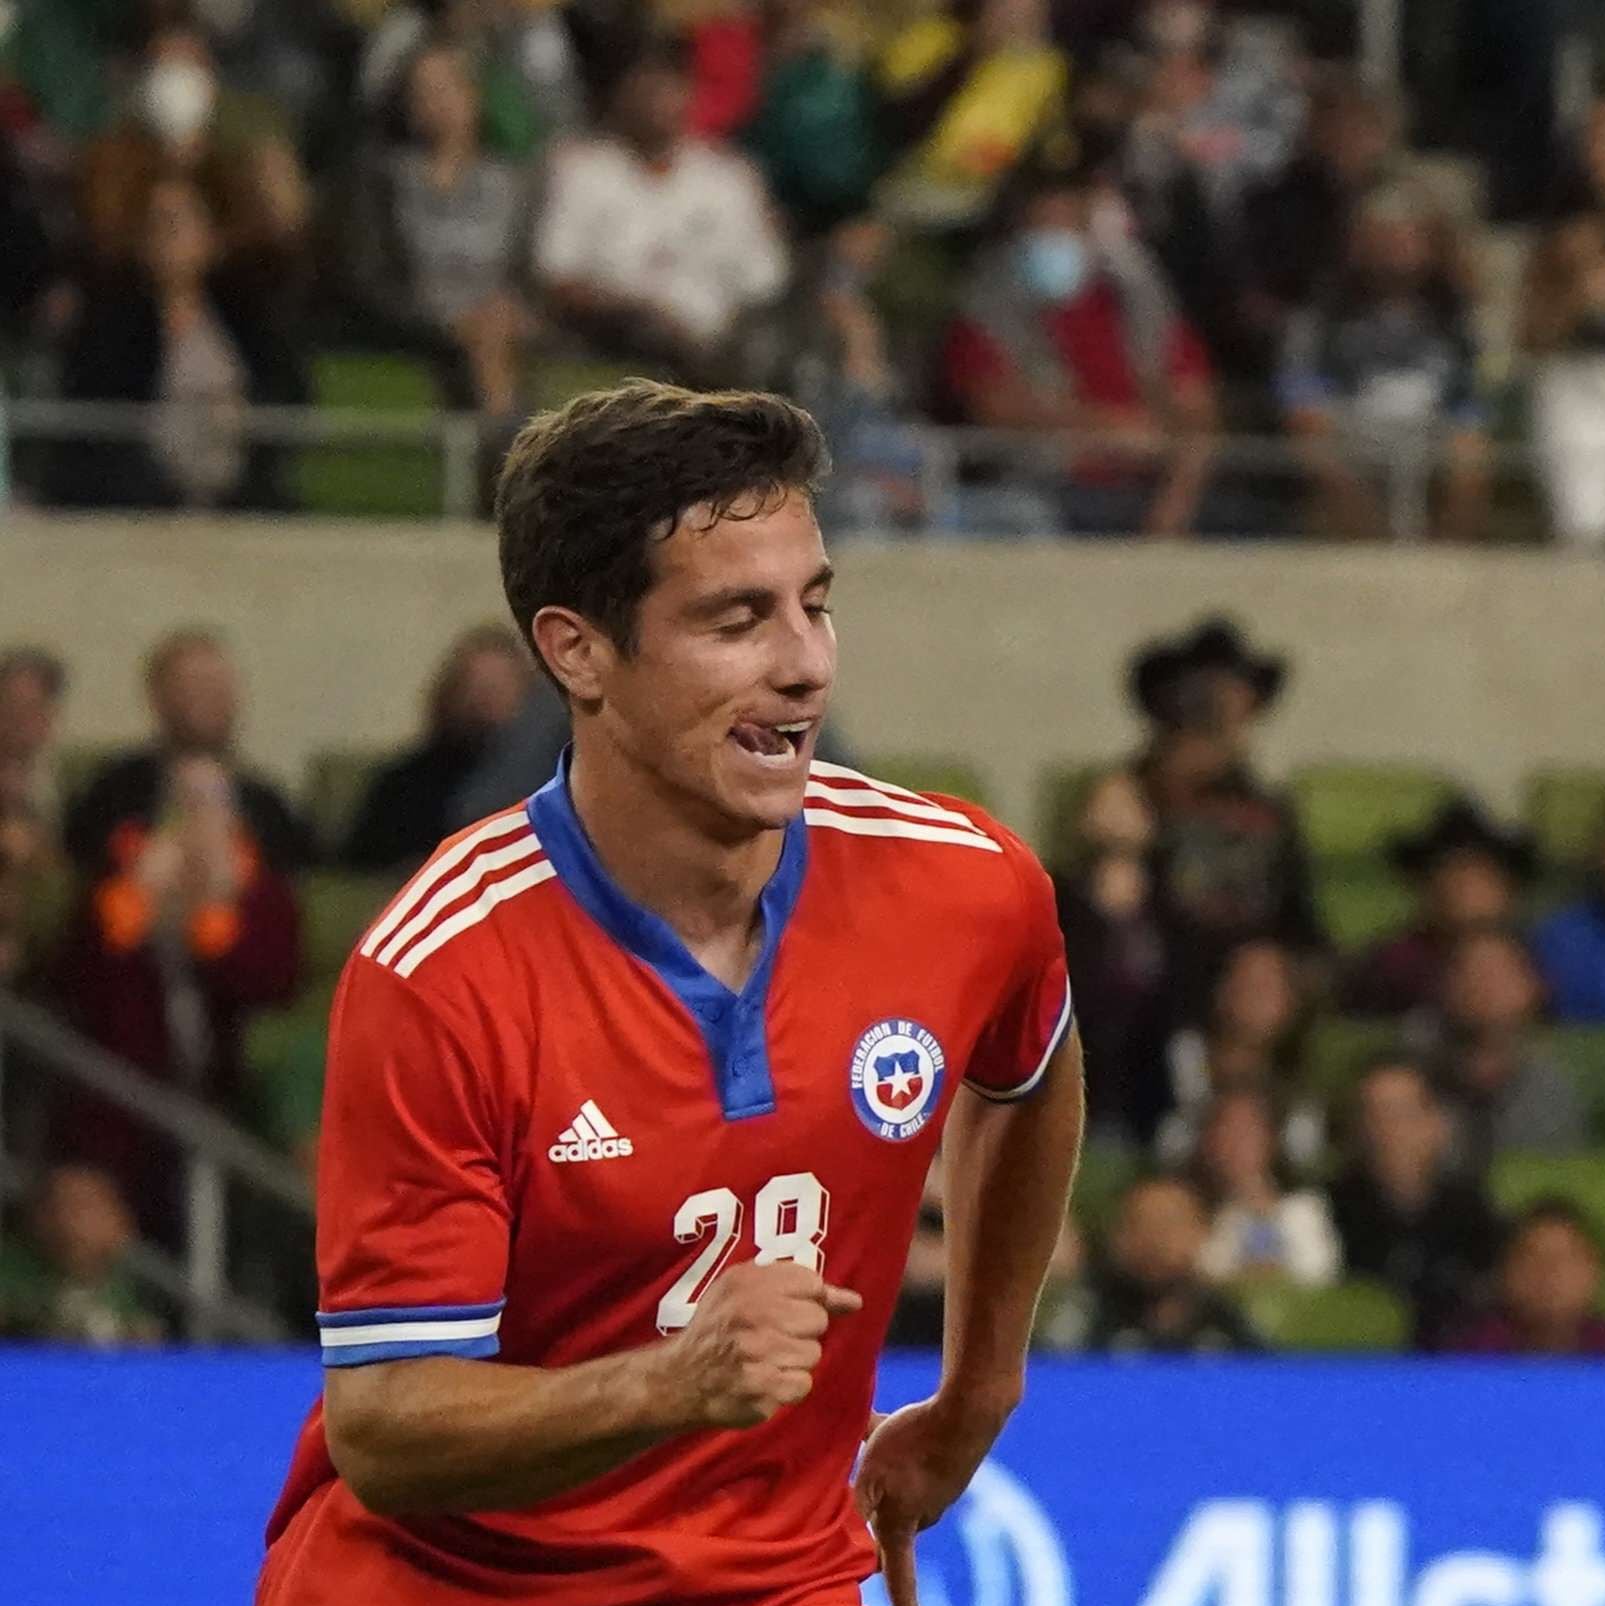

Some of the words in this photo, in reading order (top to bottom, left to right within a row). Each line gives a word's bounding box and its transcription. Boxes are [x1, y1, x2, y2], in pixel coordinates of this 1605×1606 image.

[851, 1021, 892, 1089] FEDERACION
[897, 1020, 913, 1035] DE
[916, 1028, 945, 1073] FUTBOL
[548, 1137, 634, 1163] adidas
[881, 1122, 896, 1138] DE
[656, 1171, 830, 1337] 28
